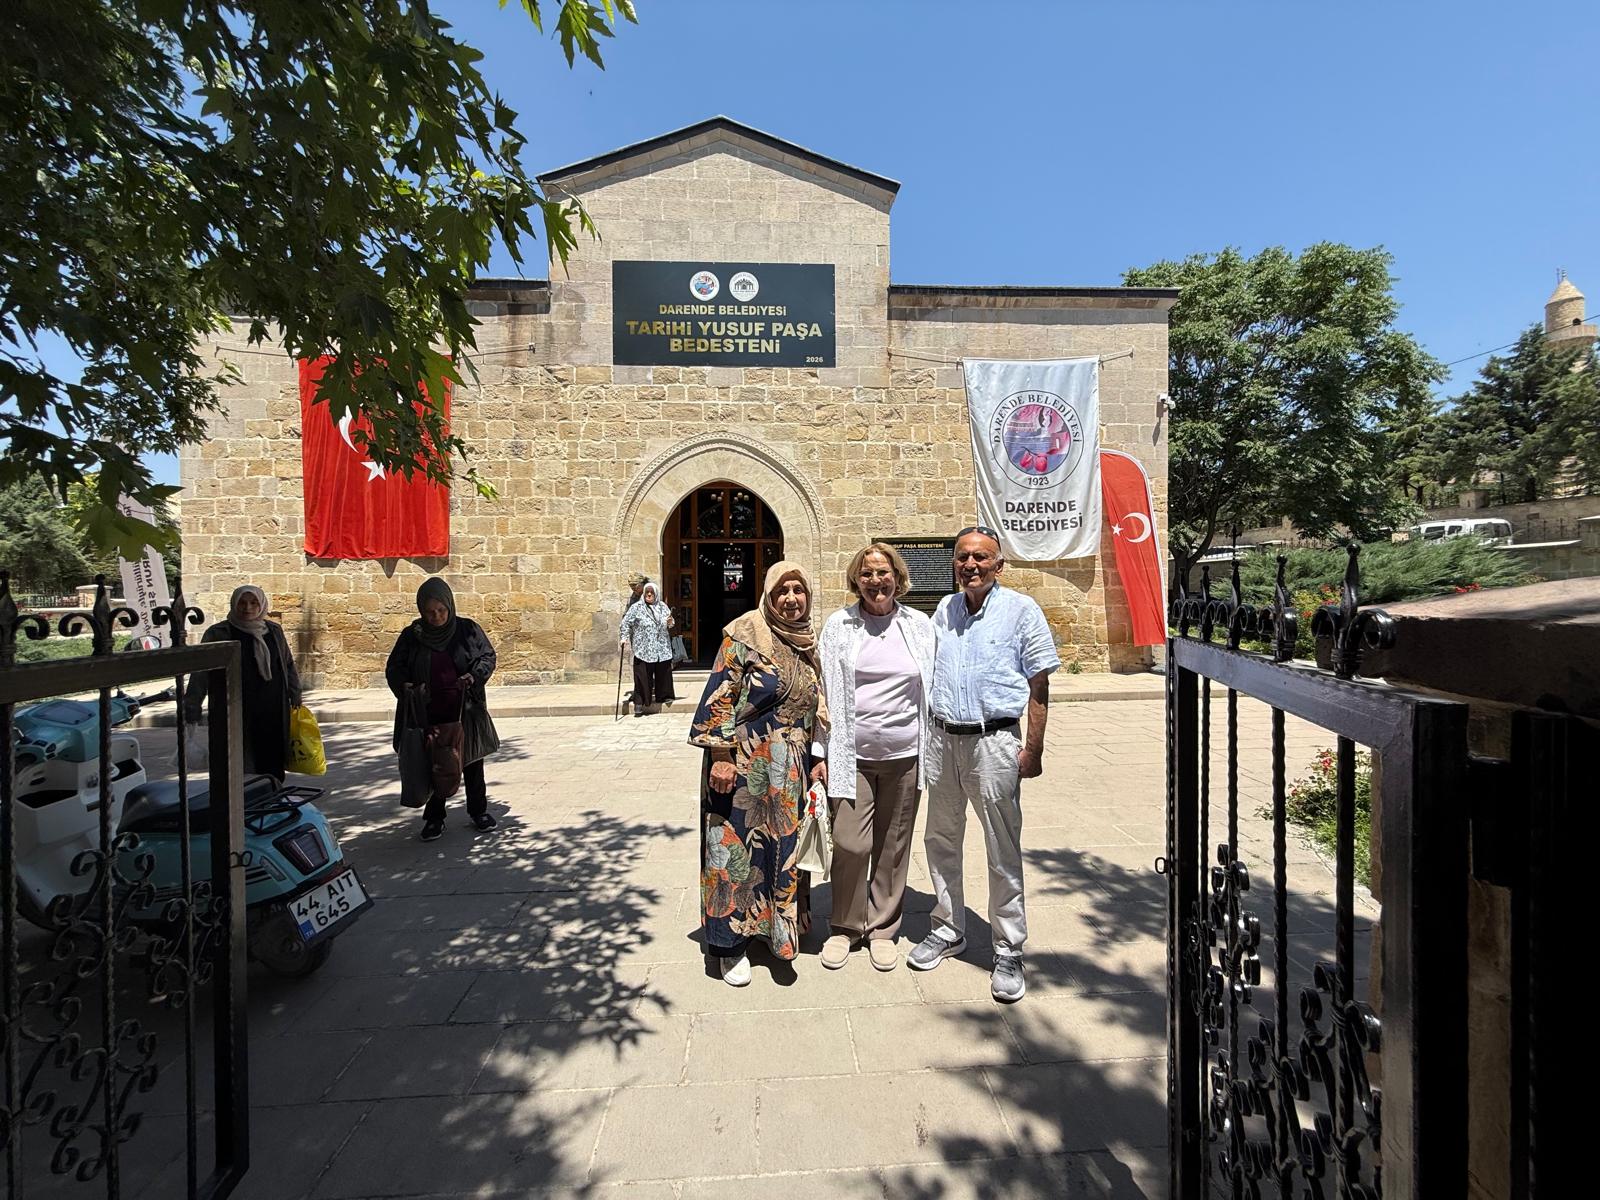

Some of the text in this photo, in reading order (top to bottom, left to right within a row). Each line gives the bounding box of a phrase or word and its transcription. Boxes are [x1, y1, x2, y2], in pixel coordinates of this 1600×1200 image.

[659, 304, 715, 316] DARENDE
[697, 321, 766, 336] YUSUF
[771, 322, 823, 340] PAŞA
[994, 395, 1025, 443] DARENDE
[1027, 476, 1050, 486] 1923
[1005, 500, 1077, 514] DARENDE
[1001, 512, 1083, 532] BELEDİYESİ
[297, 895, 320, 917] 44
[327, 872, 354, 899] AIT
[315, 896, 350, 926] 645
